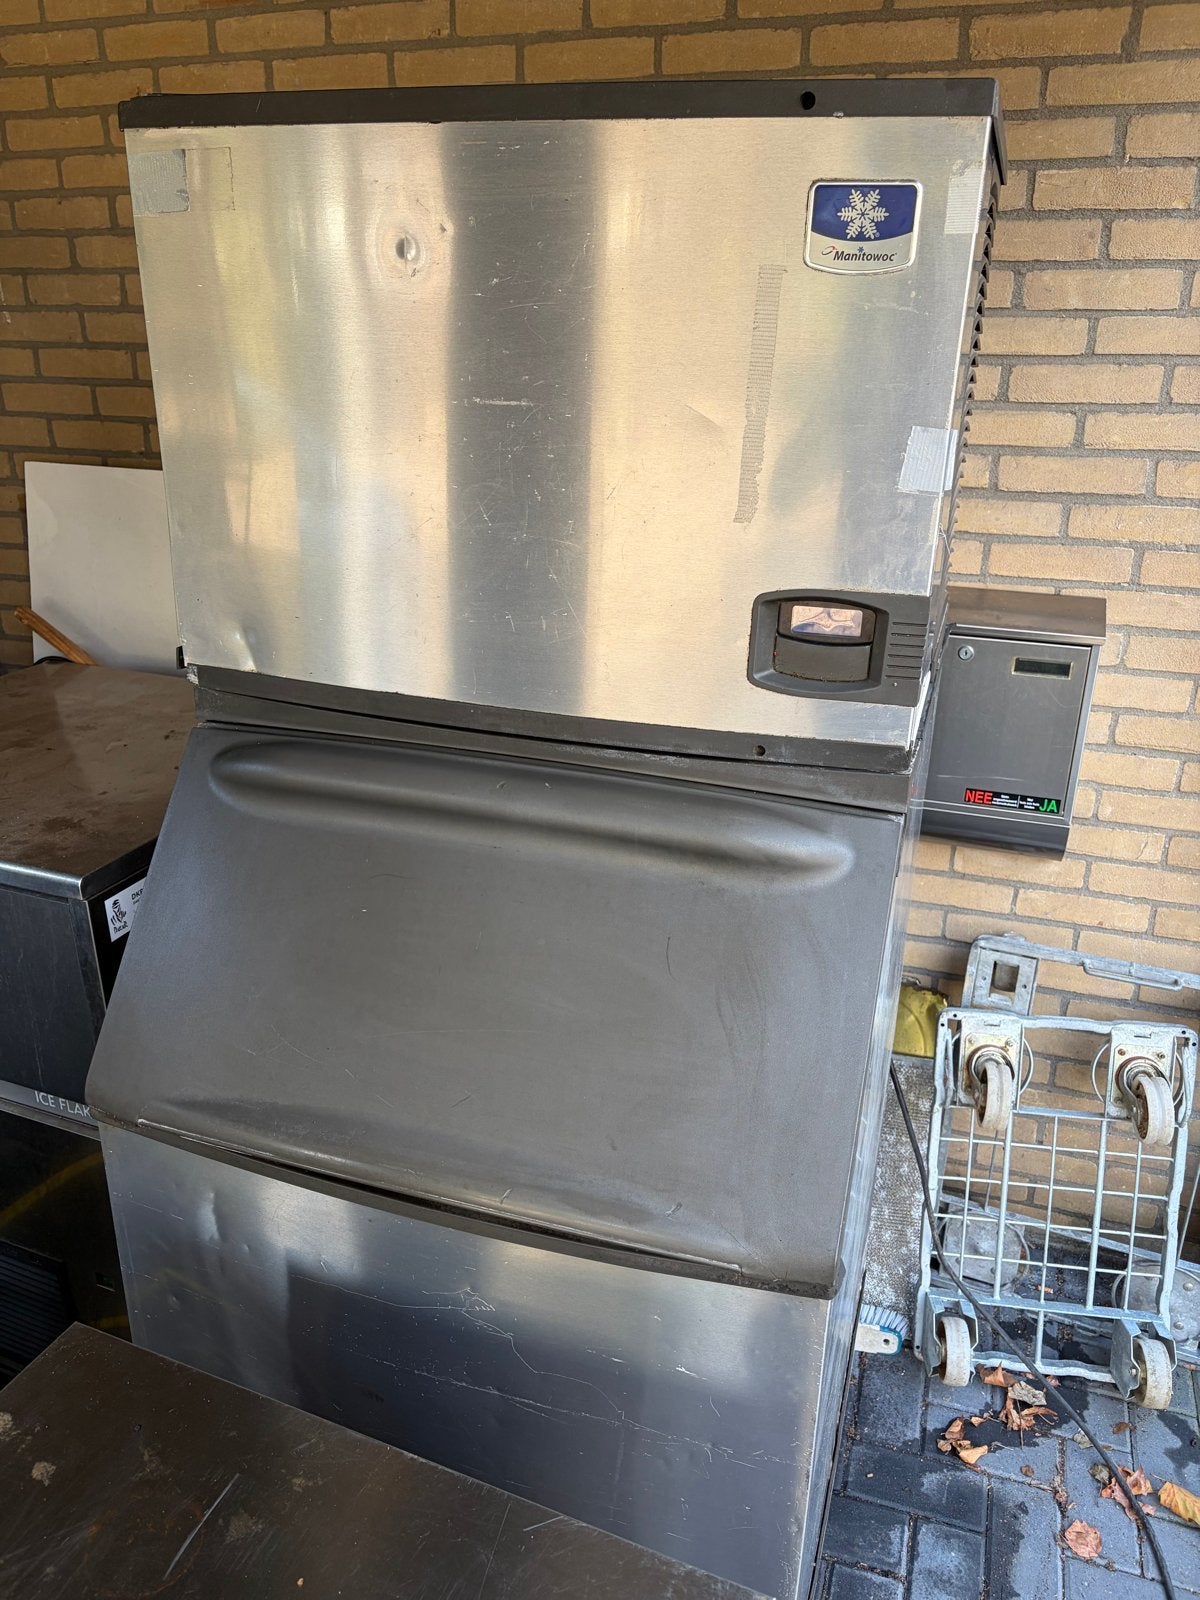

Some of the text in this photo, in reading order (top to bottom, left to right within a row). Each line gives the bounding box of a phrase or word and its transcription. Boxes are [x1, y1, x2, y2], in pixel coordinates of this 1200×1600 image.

[833, 248, 896, 262] Manitowoc
[965, 789, 993, 805] NEE
[1039, 798, 1058, 813] JA
[34, 1090, 56, 1108] ICE
